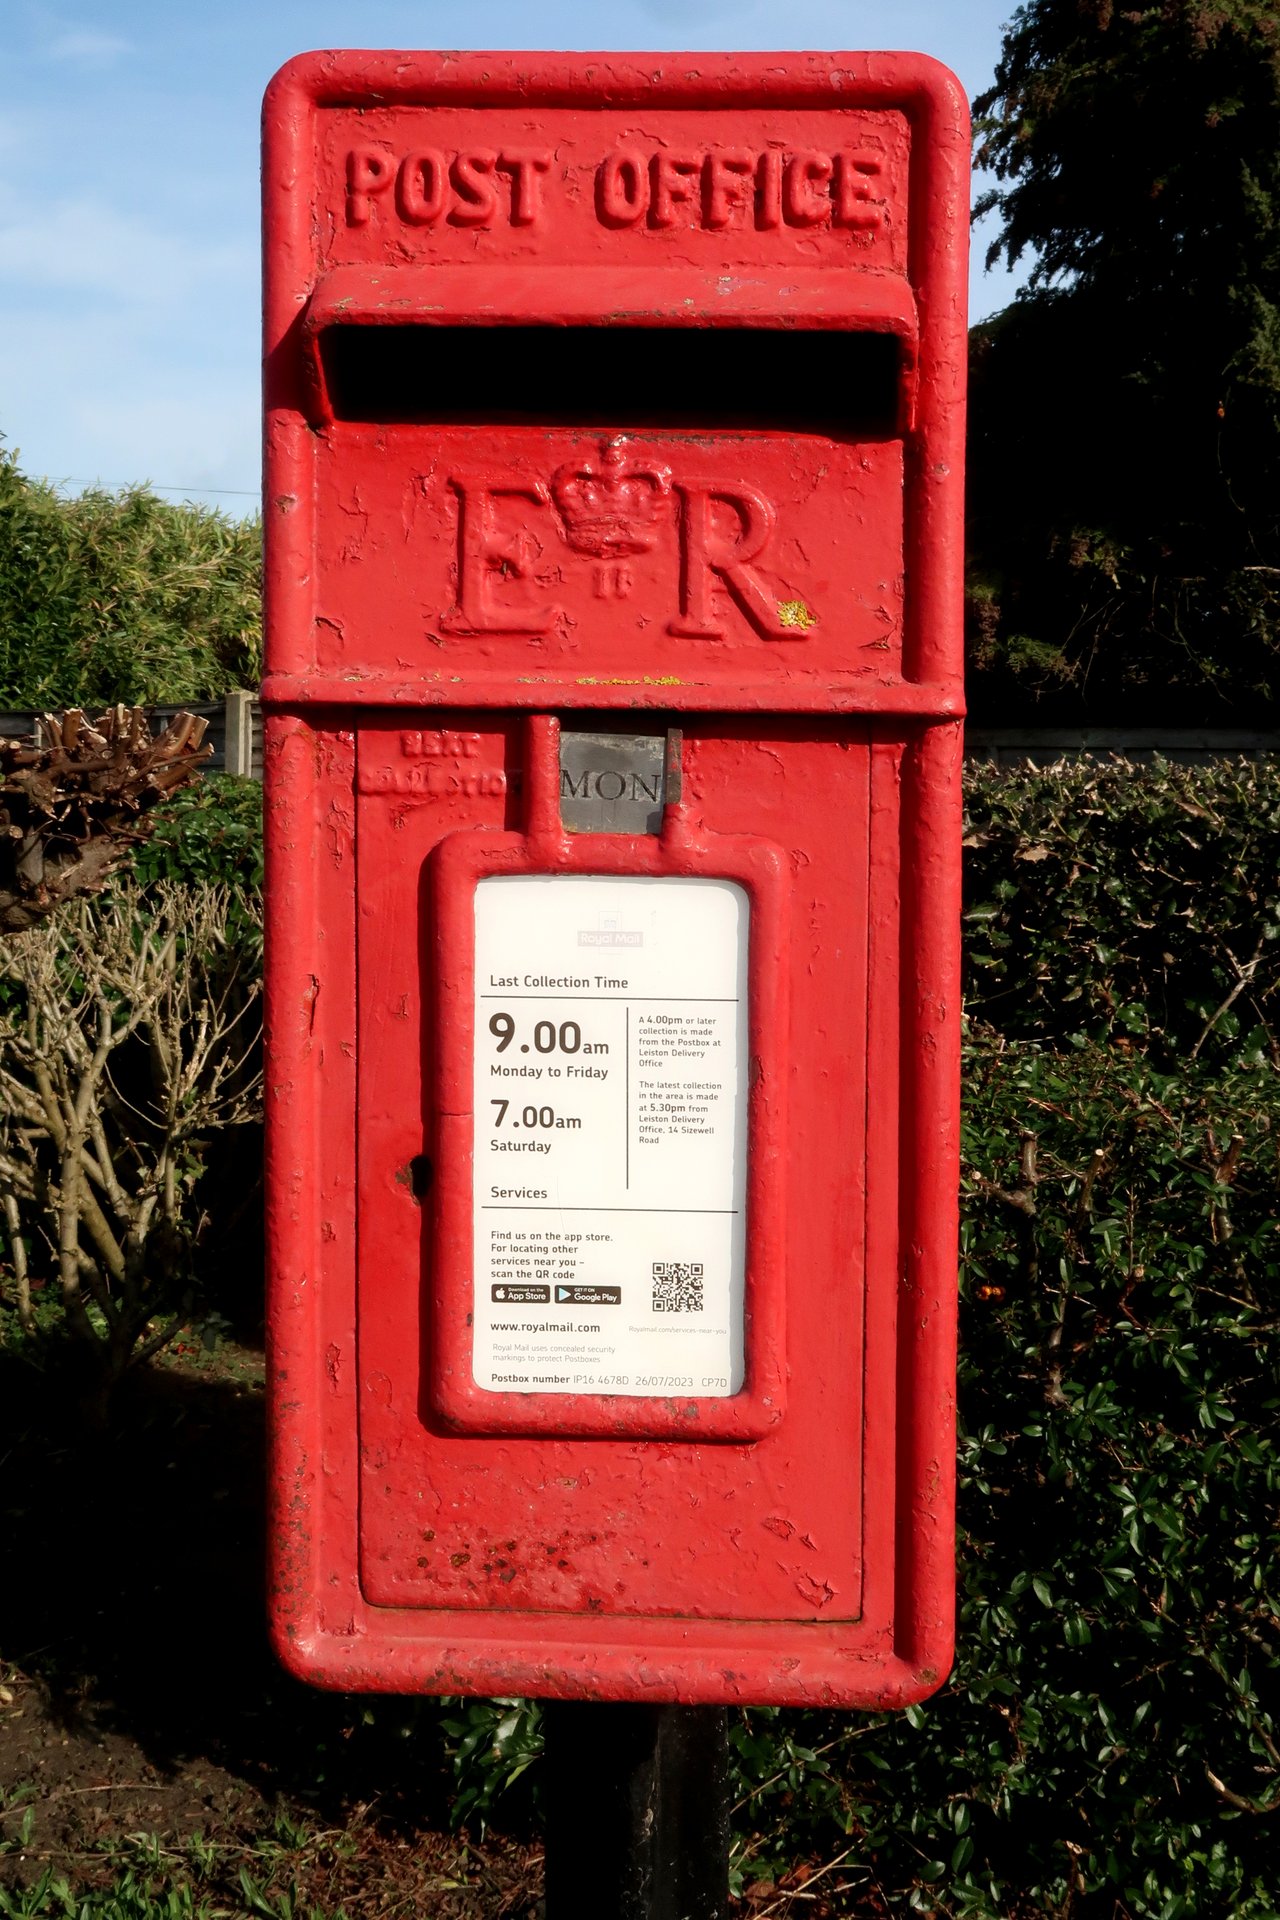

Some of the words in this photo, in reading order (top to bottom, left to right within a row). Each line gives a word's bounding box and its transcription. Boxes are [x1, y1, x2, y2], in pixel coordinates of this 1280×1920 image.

[346, 147, 550, 228] POST
[596, 147, 884, 231] OFFICE
[439, 475, 570, 637] E
[667, 477, 812, 641] R
[560, 768, 661, 802] MON
[580, 932, 612, 945] Royal
[615, 933, 641, 945] Mail
[491, 975, 519, 986] Last
[524, 975, 589, 987] Collection
[594, 976, 628, 988] Time
[647, 1016, 682, 1025] 4.00pm
[489, 1013, 608, 1054] 9.00am
[672, 1049, 705, 1058] Delivery
[491, 1065, 542, 1079] Monday
[548, 1067, 561, 1077] to
[567, 1066, 608, 1080] Friday
[651, 1103, 685, 1113] 5.30pm
[491, 1100, 581, 1128] 7.00am
[672, 1116, 704, 1124] Delivery
[491, 1140, 551, 1154] Saturday
[491, 1186, 547, 1198] Services
[492, 1231, 511, 1239] Find
[545, 1232, 560, 1240] the
[565, 1234, 582, 1242] app
[492, 1244, 507, 1252] For
[510, 1244, 548, 1254] locating
[552, 1245, 578, 1253] other
[517, 1270, 532, 1278] the
[536, 1270, 549, 1278] QR
[553, 1271, 574, 1279] code
[508, 1292, 524, 1301] App
[574, 1293, 600, 1302] Google
[602, 1294, 617, 1302] Play
[491, 1323, 600, 1333] www.royalmail.com
[493, 1344, 512, 1352] Royal
[565, 1355, 600, 1363] Postboxes
[492, 1374, 529, 1382] Postbox
[533, 1375, 570, 1383] number
[573, 1375, 594, 1384] IP16
[598, 1376, 629, 1385] 4678D
[636, 1376, 693, 1386] 26/07/2023
[702, 1378, 727, 1387] CP7D
